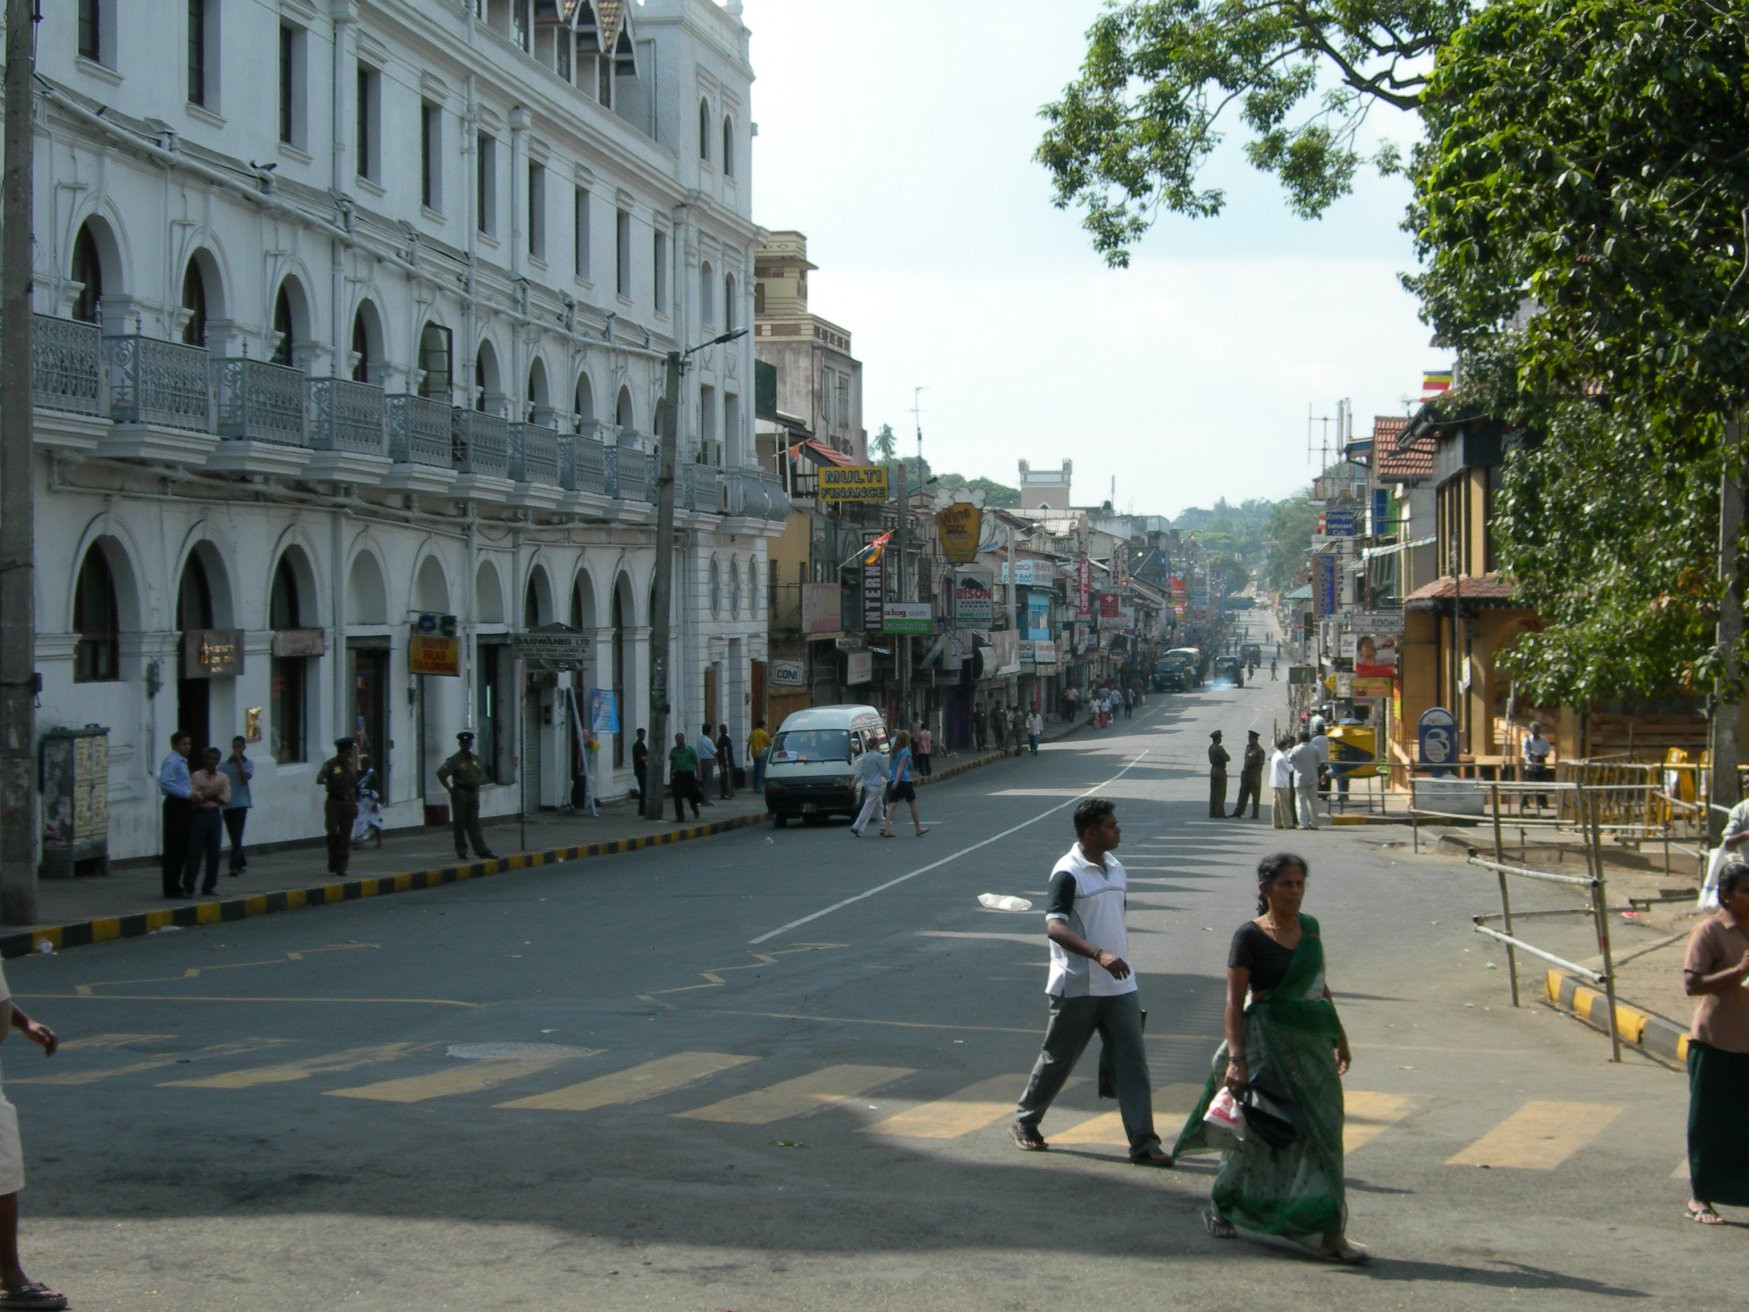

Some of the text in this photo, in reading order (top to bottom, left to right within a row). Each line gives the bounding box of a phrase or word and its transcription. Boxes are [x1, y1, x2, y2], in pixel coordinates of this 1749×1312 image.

[825, 470, 882, 484] MULTI
[821, 487, 885, 499] FINANCE
[576, 638, 591, 646] LTD
